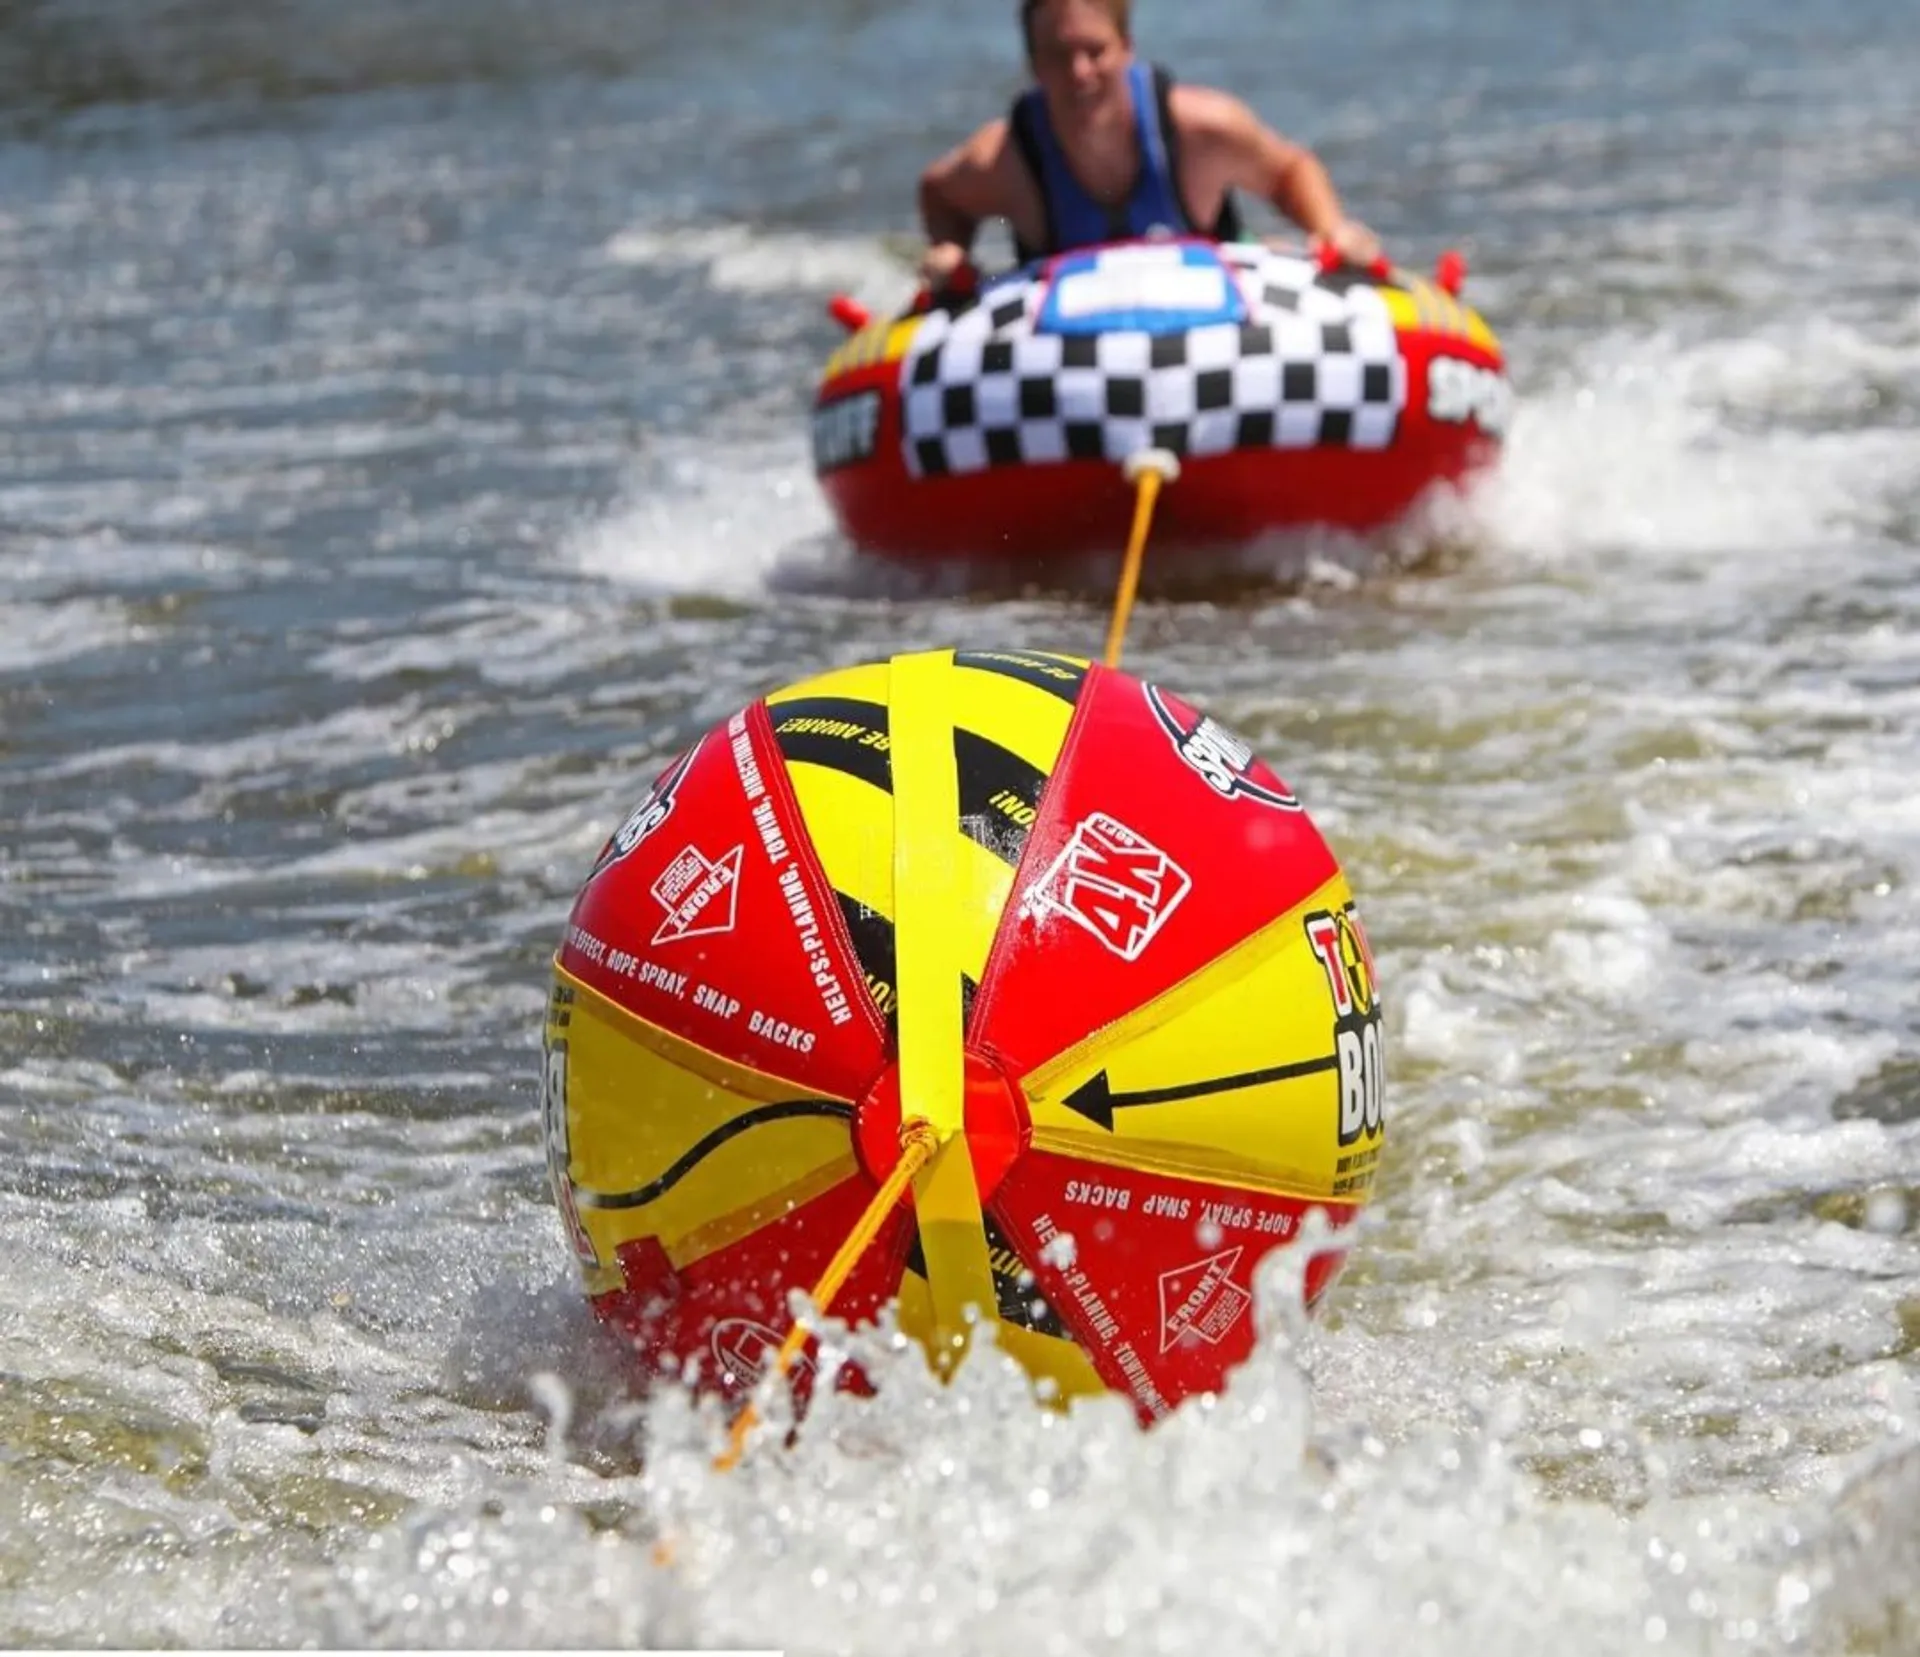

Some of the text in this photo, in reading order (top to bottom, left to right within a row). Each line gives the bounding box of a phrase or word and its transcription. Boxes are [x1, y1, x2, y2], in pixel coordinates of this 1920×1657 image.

[775, 718, 867, 740] AWARE!
[988, 791, 1036, 828] ON!
[669, 863, 733, 934] FRONT
[606, 947, 637, 979] ROPE
[638, 957, 687, 999] SPRAY,
[692, 984, 741, 1021] SNAP
[748, 1010, 817, 1054] BACKS
[1063, 1178, 1131, 1211] BACKS
[1141, 1190, 1191, 1218] SNAP
[1200, 1197, 1253, 1230] SPRAY,
[1167, 1258, 1226, 1333] FRONT
